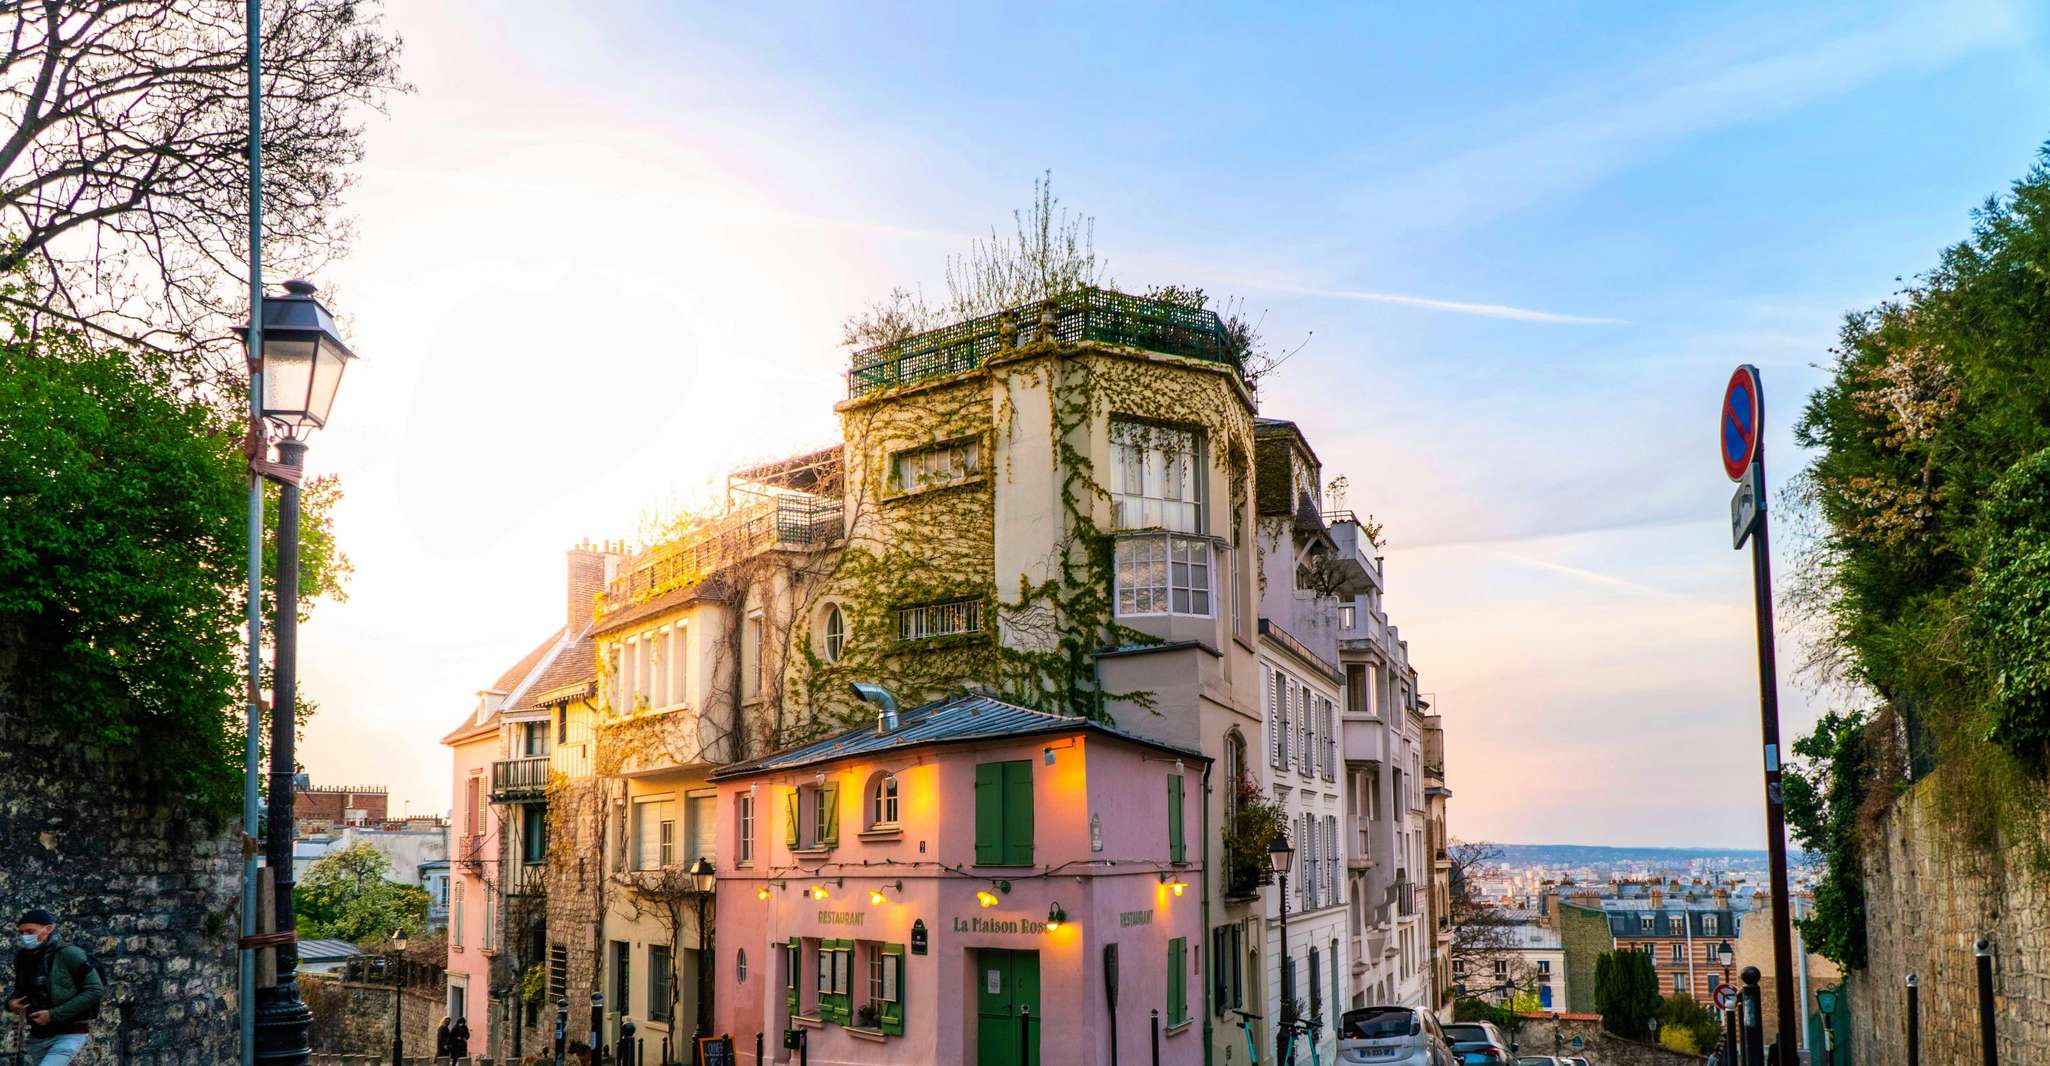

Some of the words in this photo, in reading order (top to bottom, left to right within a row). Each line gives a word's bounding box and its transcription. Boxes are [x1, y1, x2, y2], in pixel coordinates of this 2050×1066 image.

[818, 910, 865, 927] RESTAURANT
[953, 917, 969, 932] La
[972, 917, 1018, 934] Maison
[1120, 909, 1154, 929] RESTAURANT
